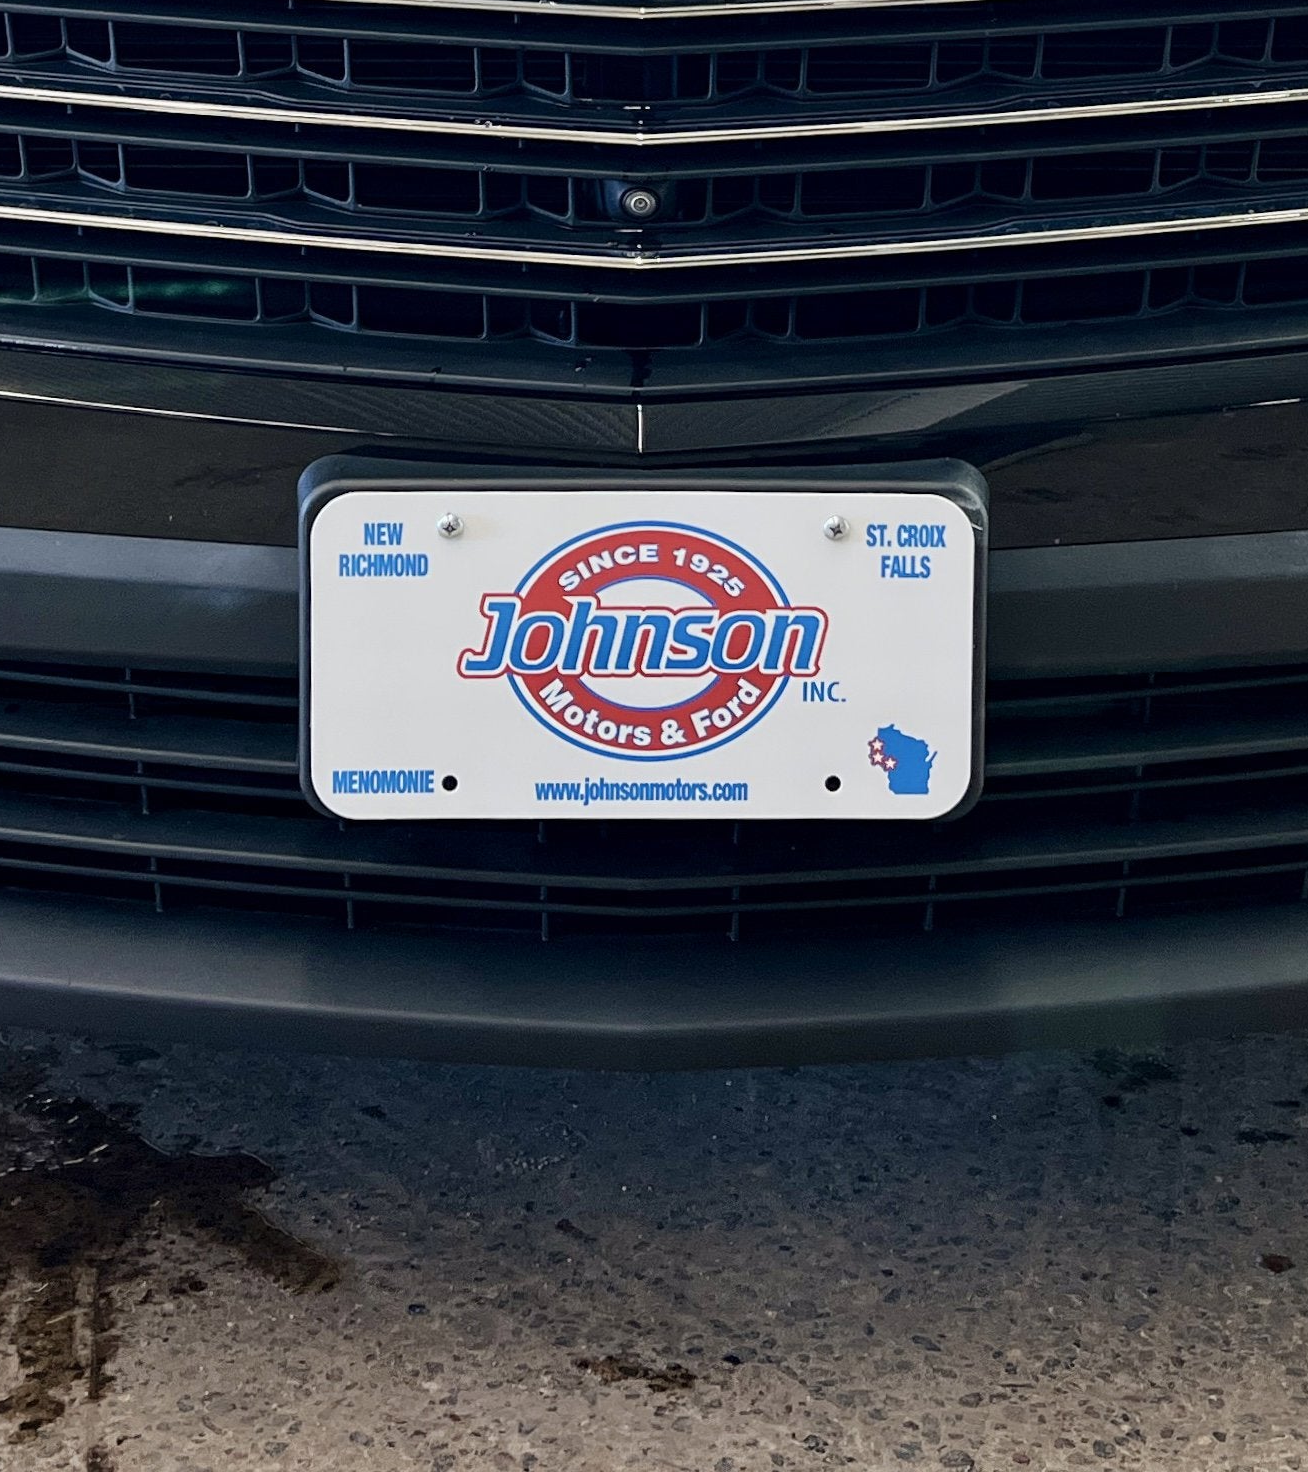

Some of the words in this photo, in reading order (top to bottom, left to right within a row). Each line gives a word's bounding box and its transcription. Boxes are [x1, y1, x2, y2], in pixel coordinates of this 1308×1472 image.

[362, 521, 404, 547] NEW
[866, 523, 891, 549] ST.
[896, 523, 947, 549] CROIX
[338, 552, 430, 578] RICHMOND
[558, 544, 660, 593] SINCE
[671, 546, 746, 598] 1925
[880, 554, 932, 580] FALLS
[461, 598, 822, 674] Johnson
[802, 681, 847, 704] INC.
[538, 678, 652, 747] Motors
[659, 719, 688, 747] &
[689, 677, 763, 739] Ford
[331, 768, 436, 795] MENOMONIE
[534, 777, 749, 807] www.johnsonmotors.com
